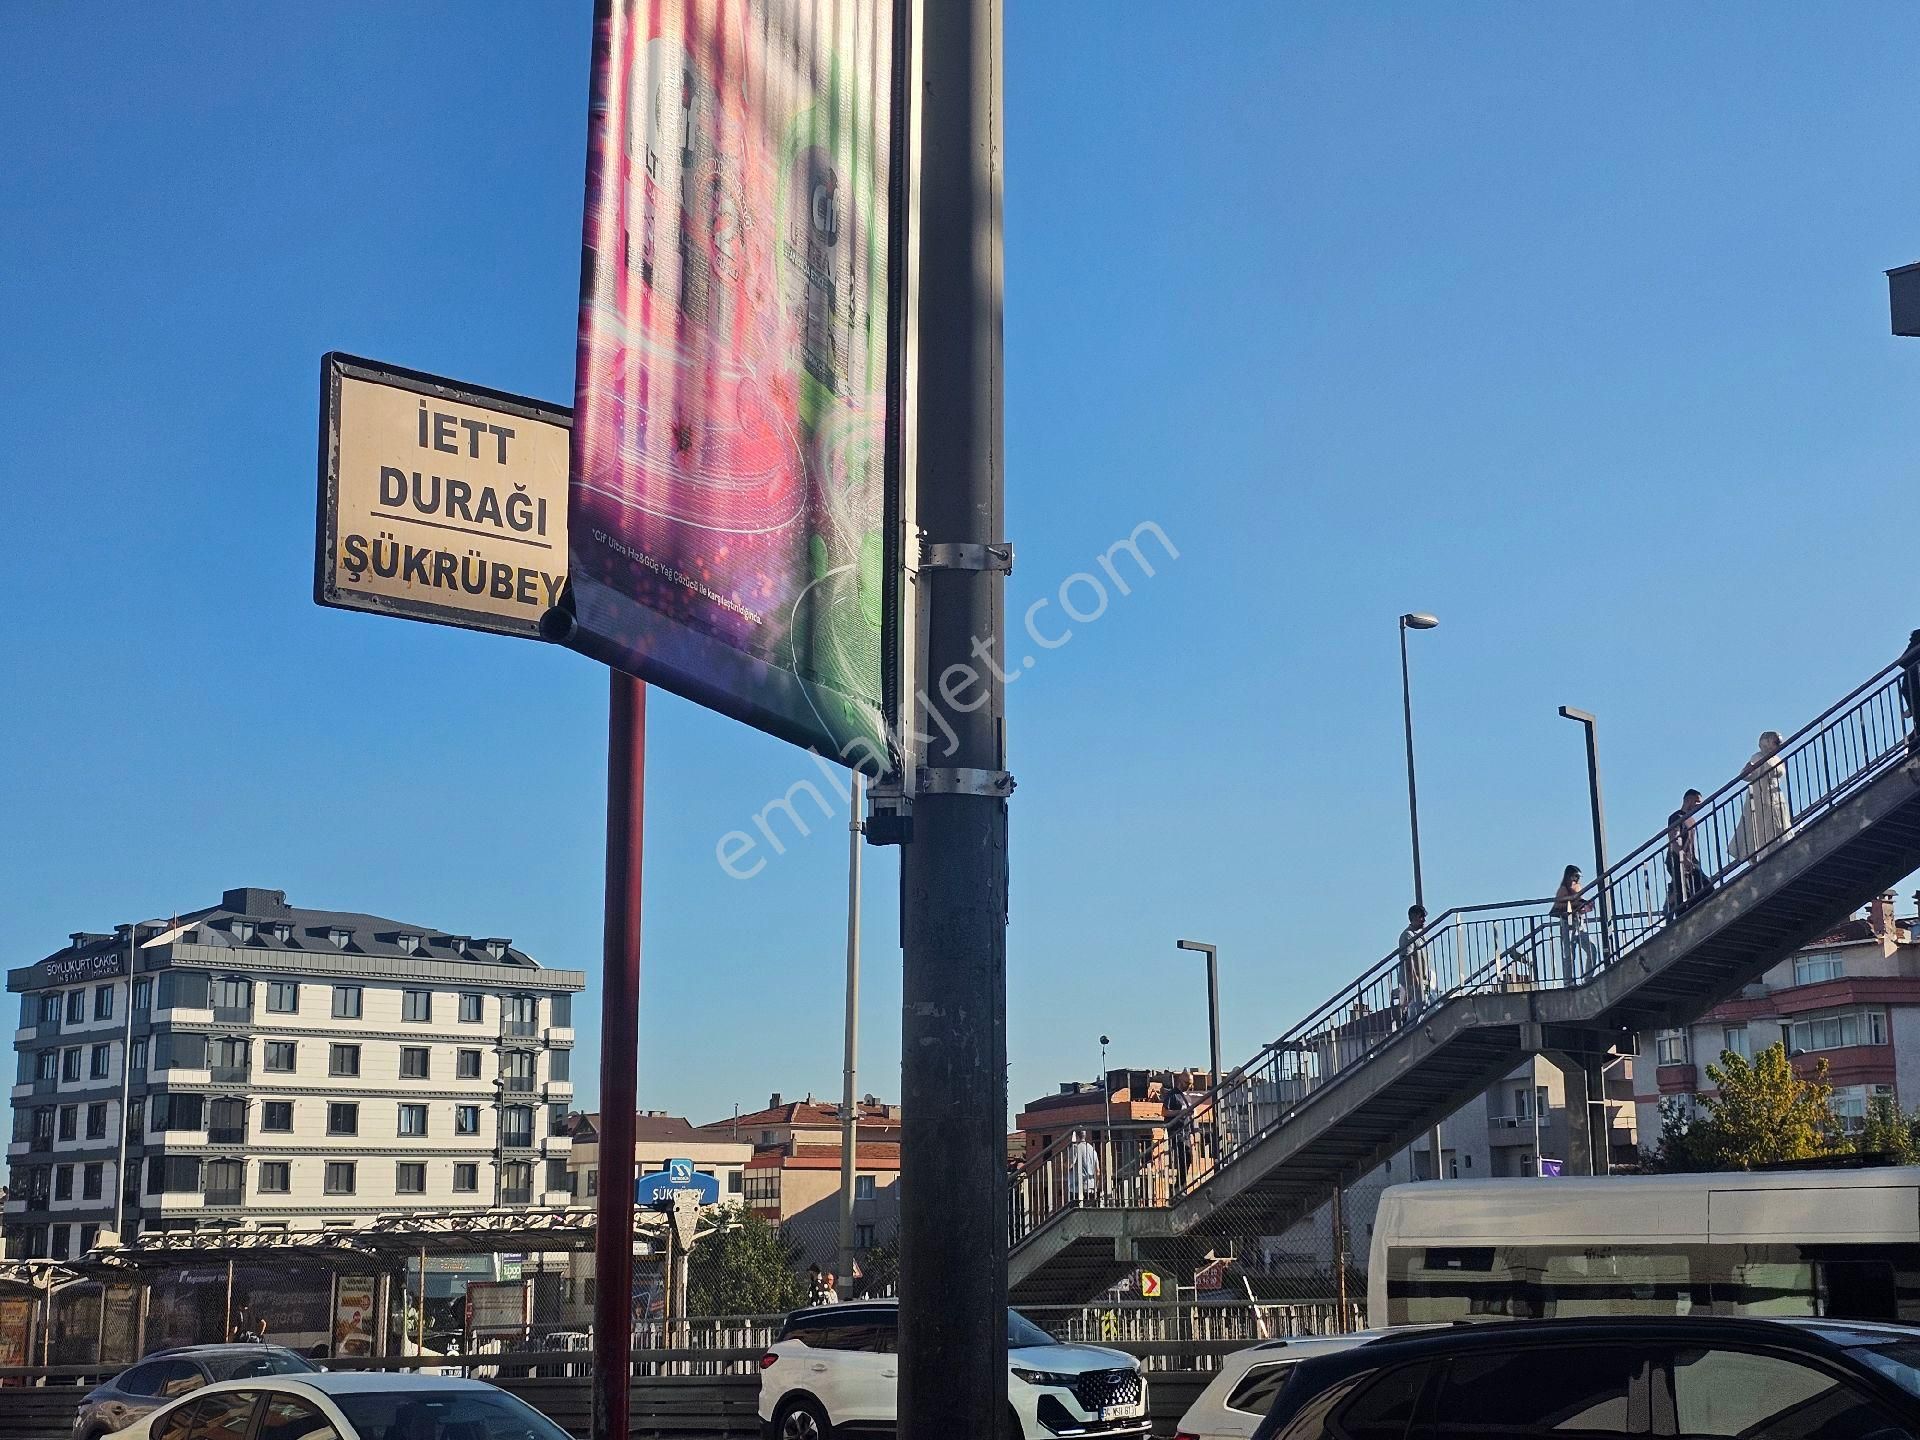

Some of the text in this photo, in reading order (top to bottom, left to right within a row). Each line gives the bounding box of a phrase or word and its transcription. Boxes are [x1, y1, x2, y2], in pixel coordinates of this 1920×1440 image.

[418, 399, 516, 465] İETT
[379, 465, 547, 536] DURAĞI
[343, 532, 564, 607] ŞÜKRÜBEY
